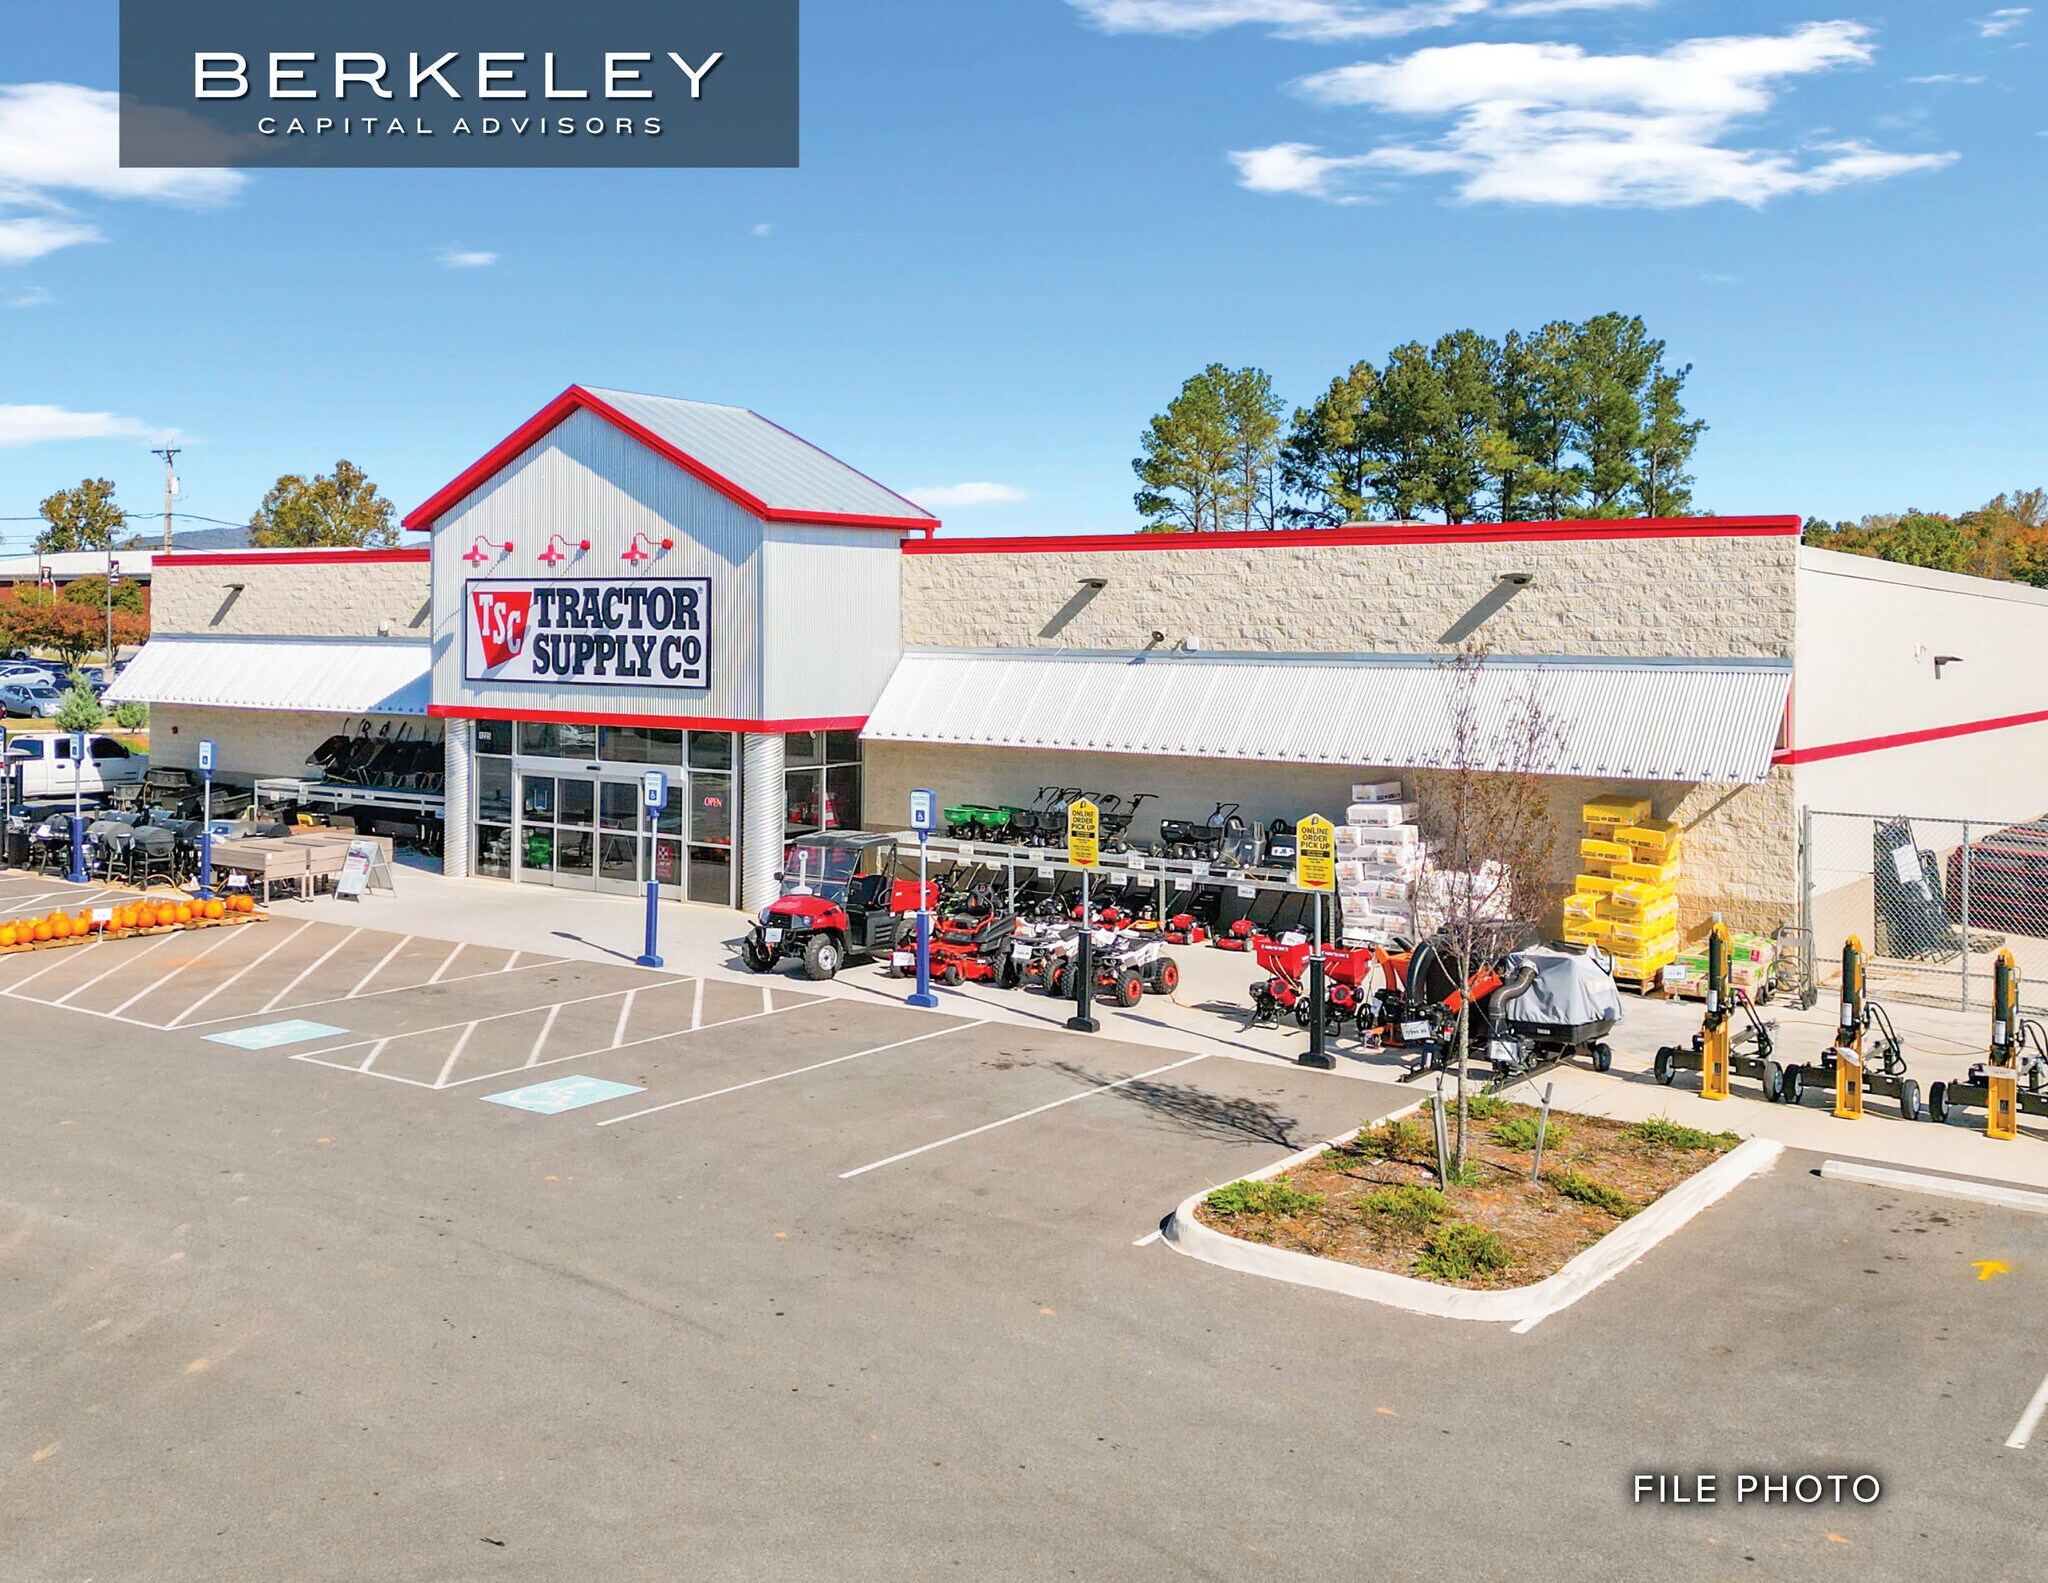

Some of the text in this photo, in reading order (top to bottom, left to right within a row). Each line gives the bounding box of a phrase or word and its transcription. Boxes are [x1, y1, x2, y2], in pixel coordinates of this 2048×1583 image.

[533, 586, 700, 630] TRACTOR
[479, 593, 521, 654] TSC
[533, 633, 657, 677] SUPPLY
[704, 796, 722, 807] OPEN
[1301, 826, 1329, 835] ONLINE
[1302, 834, 1328, 842] ORDER
[1300, 841, 1319, 849] PICK
